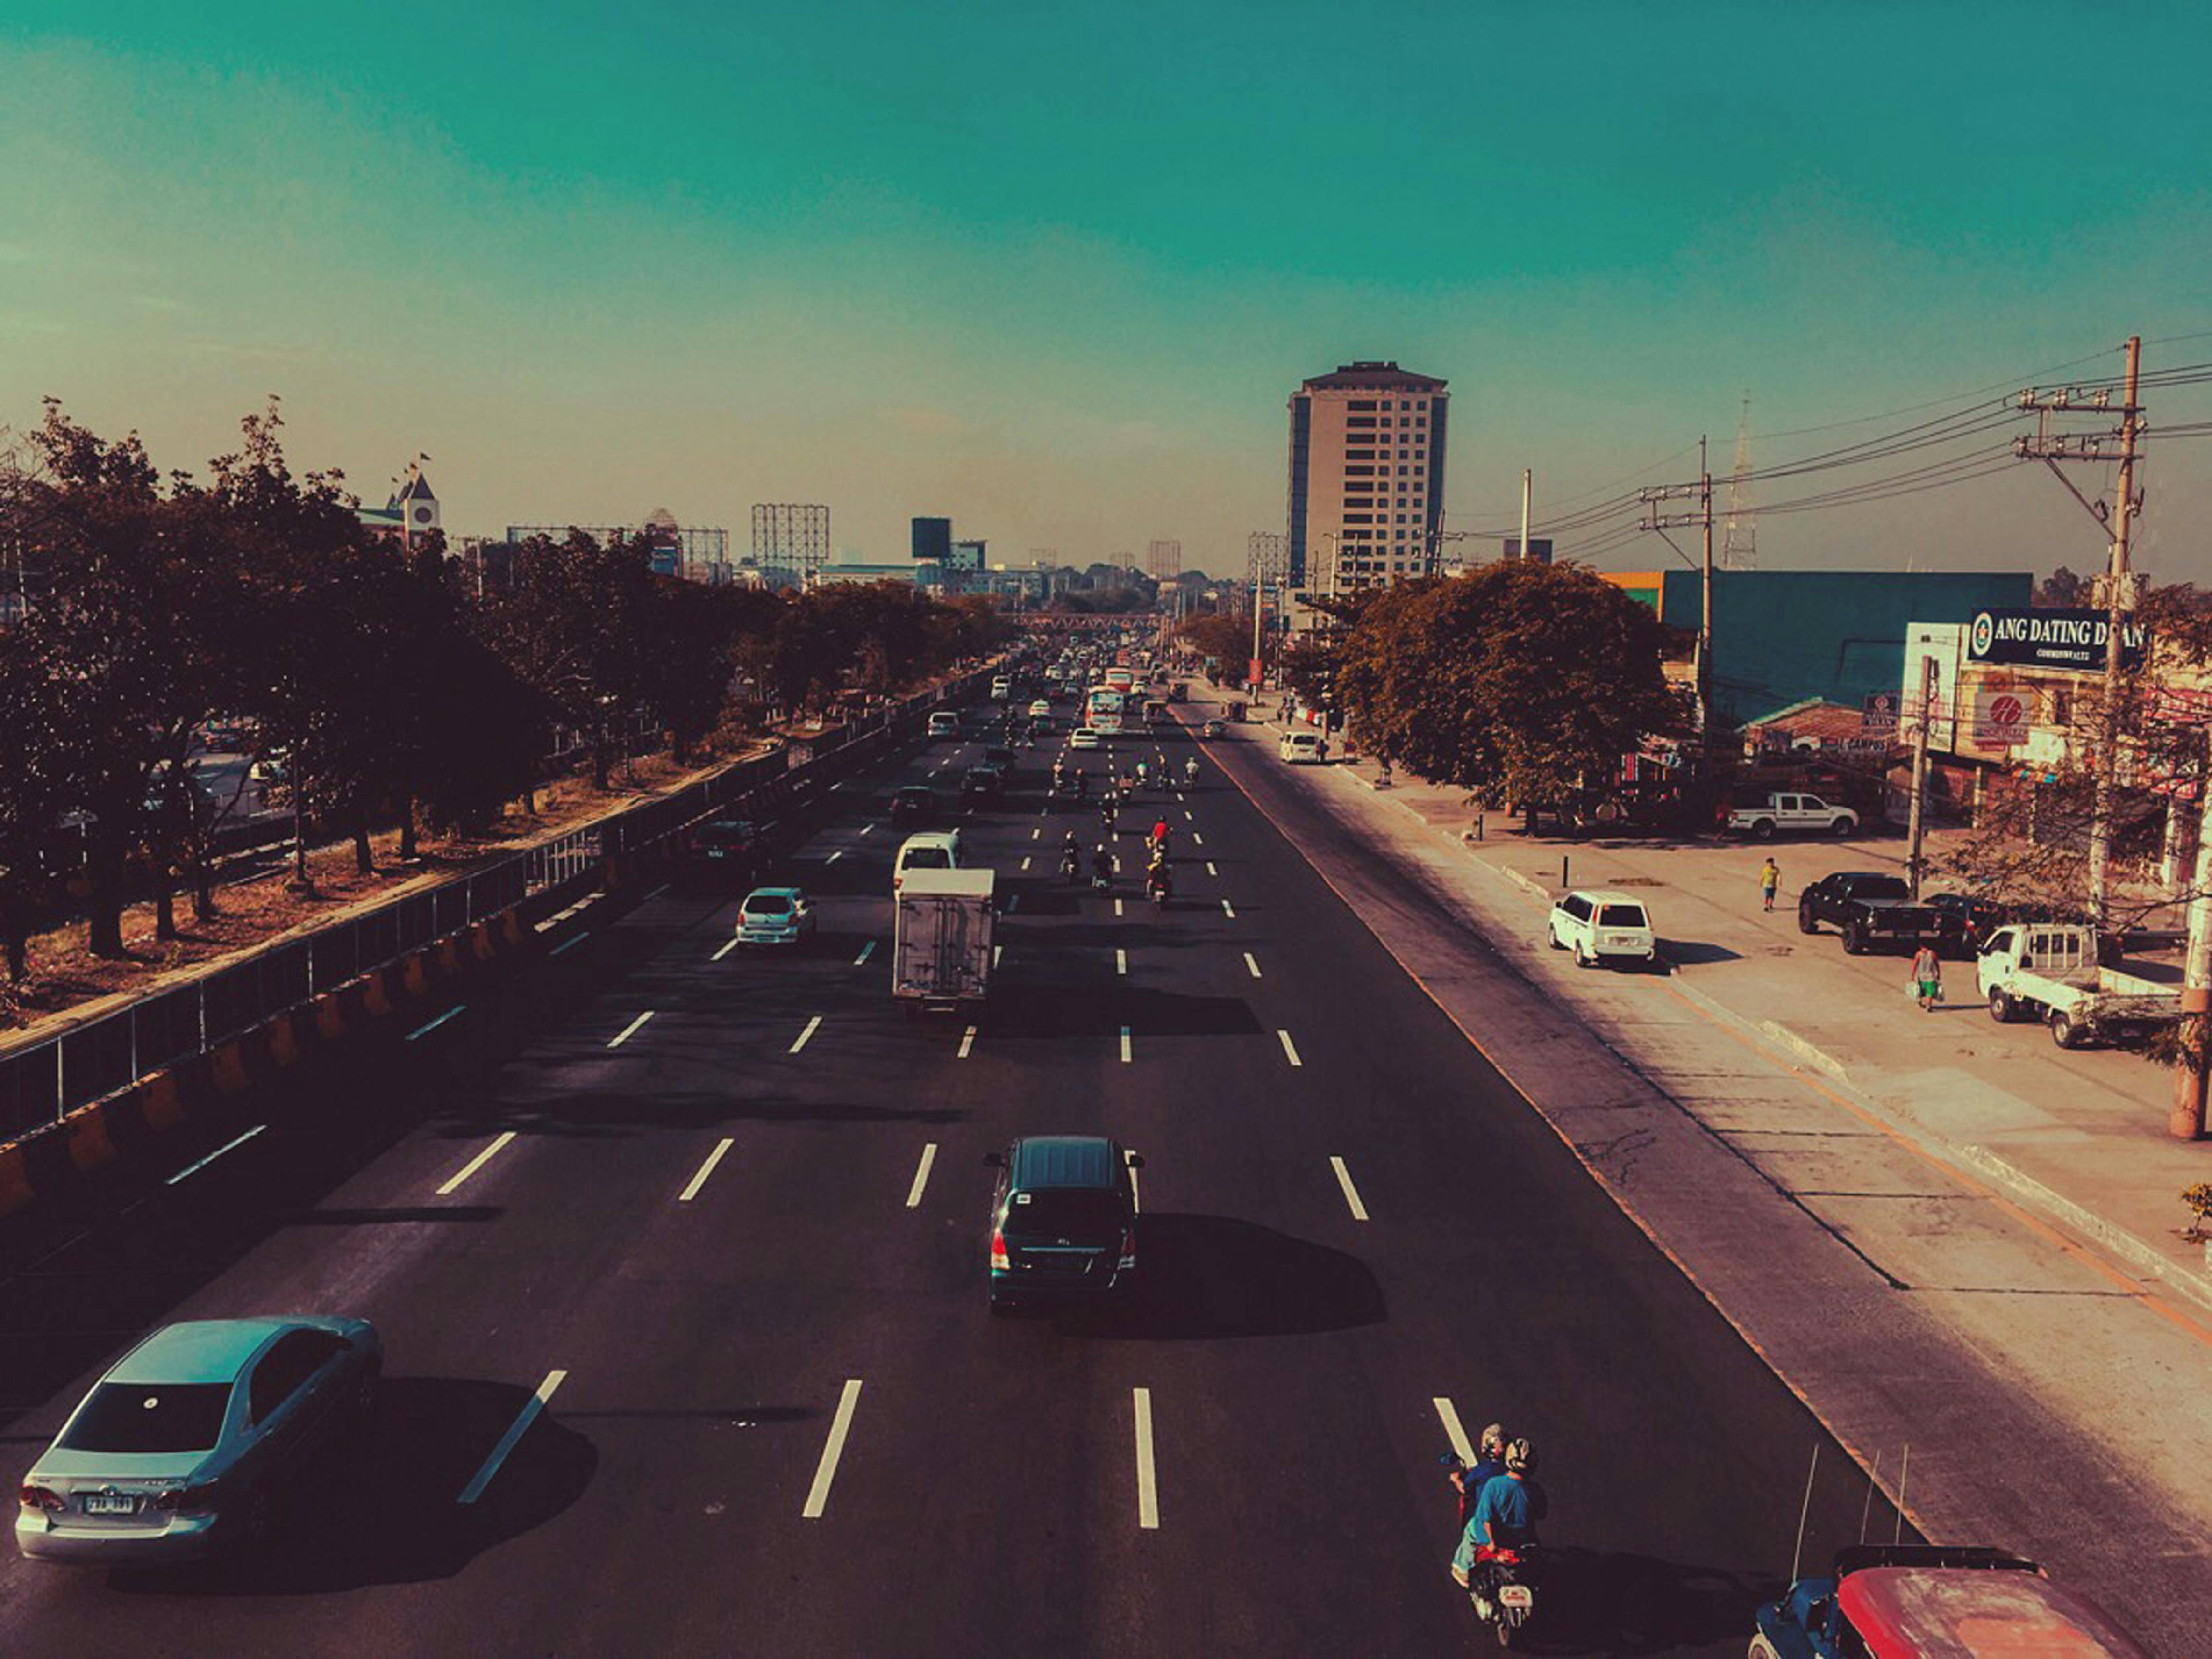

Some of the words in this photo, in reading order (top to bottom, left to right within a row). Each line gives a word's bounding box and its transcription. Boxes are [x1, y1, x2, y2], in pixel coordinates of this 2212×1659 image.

[1995, 618, 2028, 642] ANG
[2029, 619, 2091, 644] DATING
[2094, 622, 2146, 648] DAN
